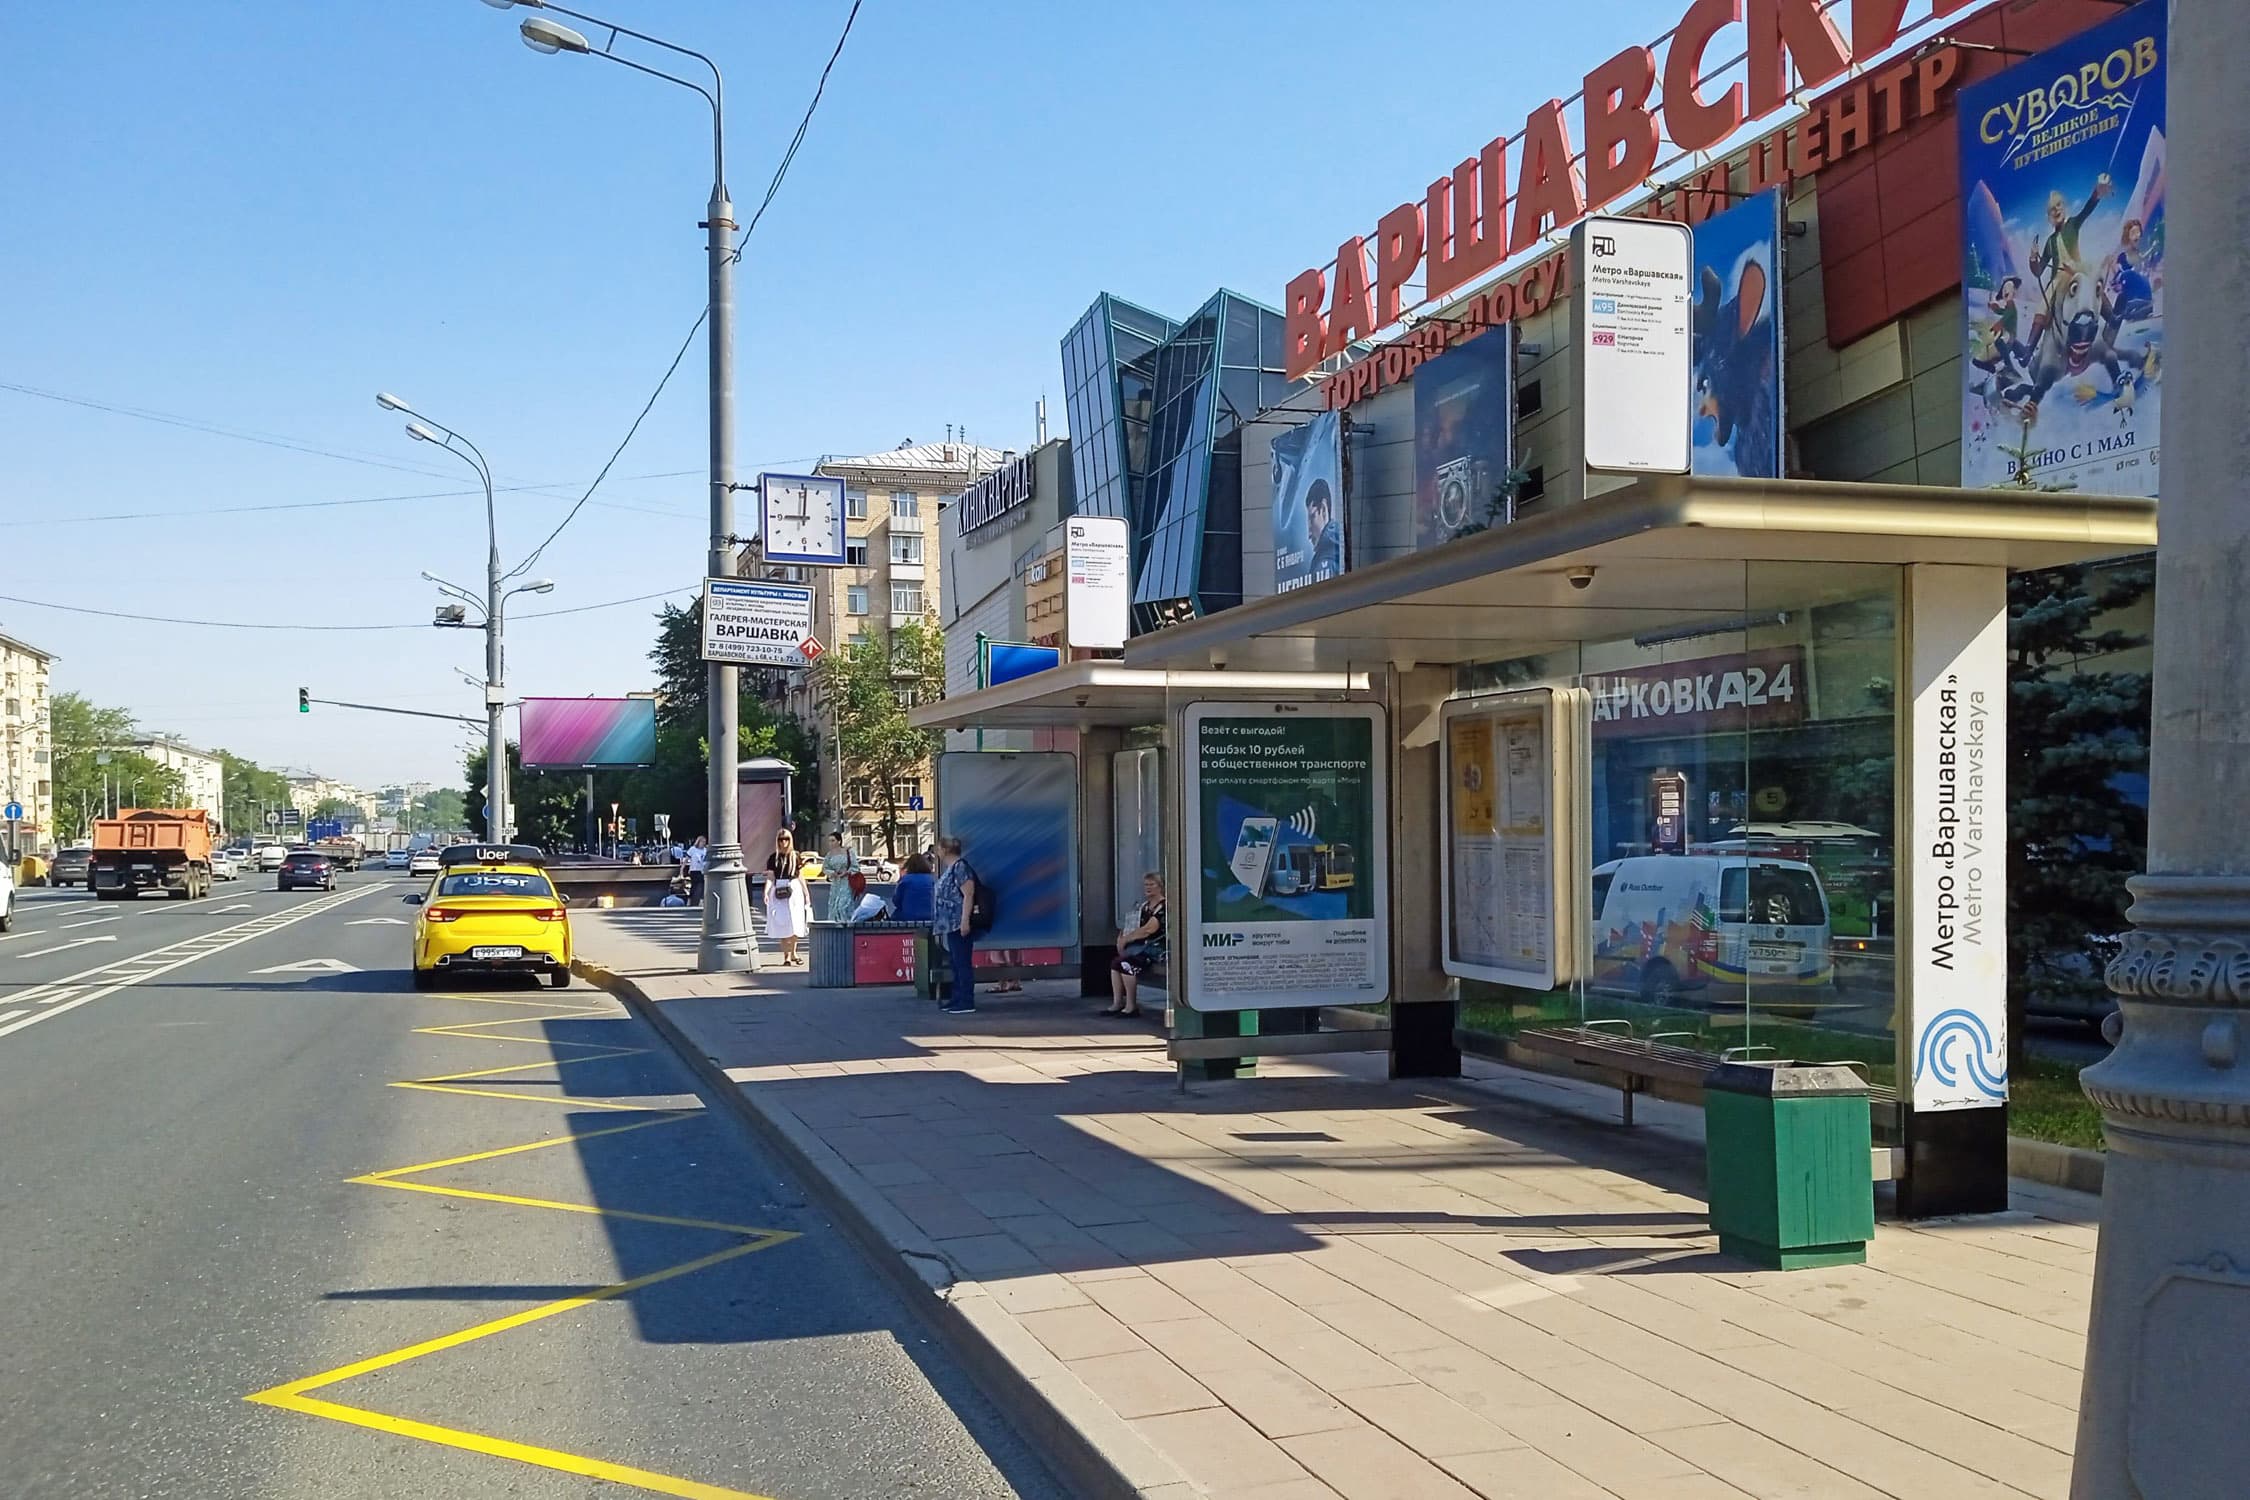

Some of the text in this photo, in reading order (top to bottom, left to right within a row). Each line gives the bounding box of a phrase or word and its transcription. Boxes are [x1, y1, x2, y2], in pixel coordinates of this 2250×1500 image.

[1980, 36, 2158, 144] СУВОРОВ
[1748, 46, 1961, 200] ЦЕНТР
[2032, 107, 2099, 148] ВЕЛИКОЕ
[2013, 113, 2120, 171] ПУТЕШЕСТВИЕ
[1286, 0, 1985, 383] ВАРШАВСК
[1592, 264, 1684, 281] Метро «Варшавская»
[1592, 276, 1611, 284] Metro
[2007, 460, 2017, 475] В
[2088, 441, 2093, 456] 1
[2098, 431, 2136, 453] МАЯ
[957, 457, 1030, 538] КИНОКВАРТАЛ
[777, 513, 830, 524] 9 3
[801, 537, 807, 545] 6
[710, 613, 808, 629] ГАЛЕРЕЯ-МАСТЕРСКАЯ
[716, 624, 800, 643] ВАРШАВКА
[708, 650, 746, 659] ВАРШАВСКОЕ
[725, 643, 745, 653] (499)
[1592, 663, 1794, 721] АРКОВКА24
[1201, 726, 1230, 735] Везёт
[1240, 726, 1286, 737] выгодой!
[1201, 745, 1305, 757] Кешбэк 10 рублей
[1201, 758, 1367, 772] в общественном транспорте
[1201, 777, 1217, 786] при
[1218, 777, 1246, 785] оплате
[1248, 776, 1299, 786] смартфоном
[1931, 673, 1960, 971] Метро «Варшавская»
[1962, 690, 1989, 946] Metro Varshavskaya
[476, 848, 510, 860] Uber
[463, 872, 529, 888] Uber
[1203, 933, 1245, 948] МИР
